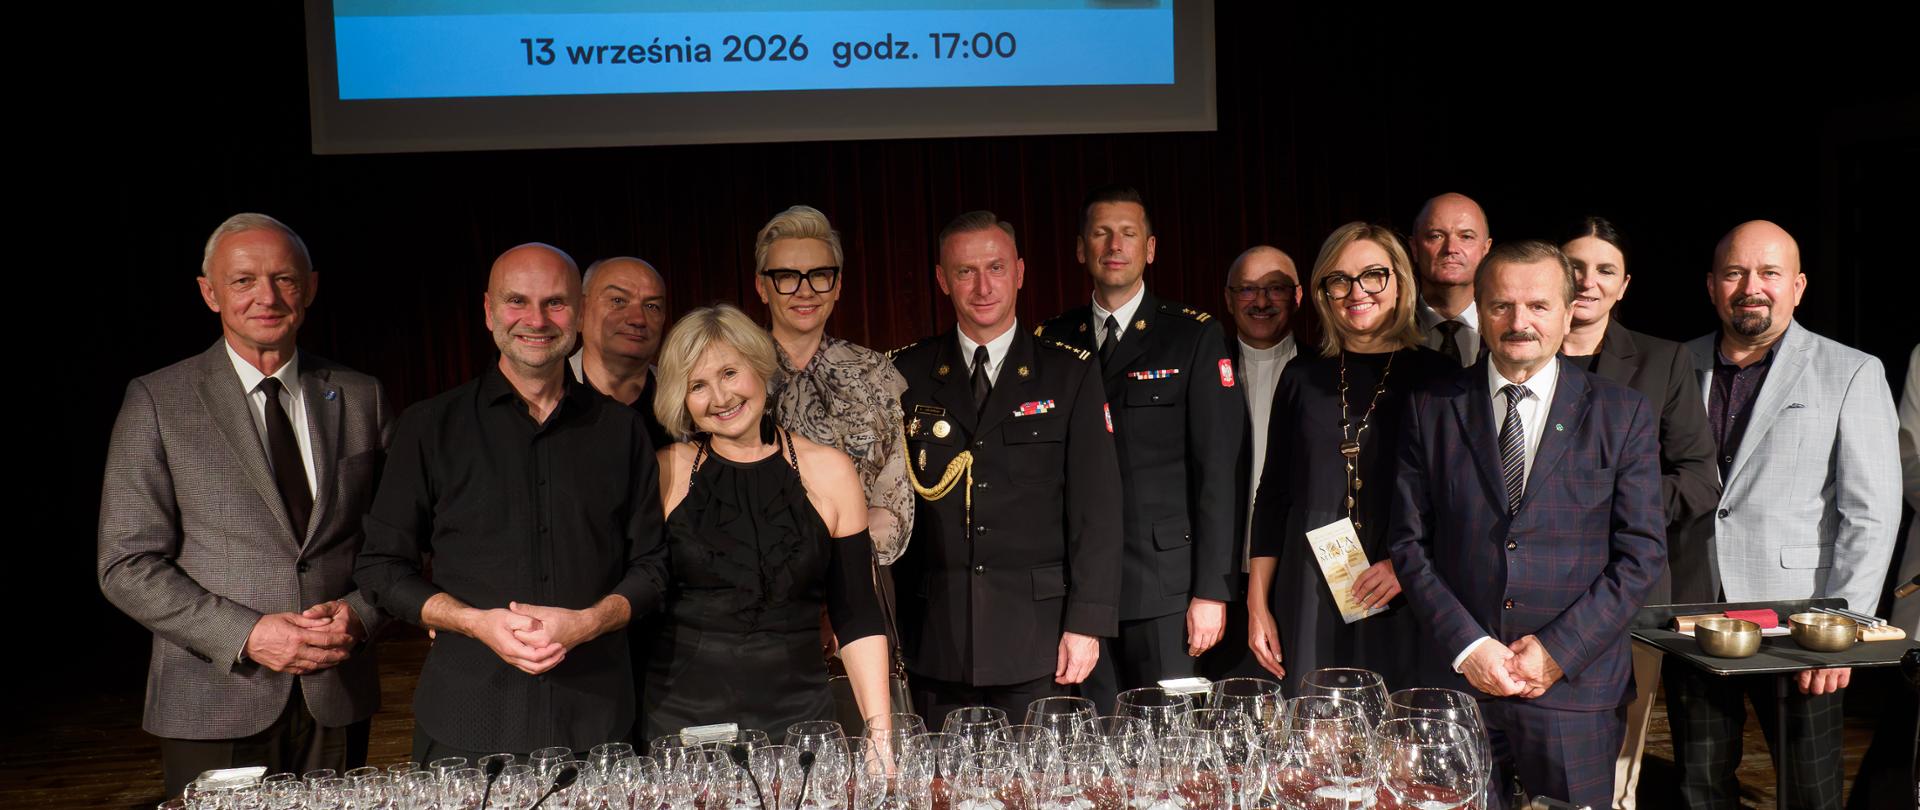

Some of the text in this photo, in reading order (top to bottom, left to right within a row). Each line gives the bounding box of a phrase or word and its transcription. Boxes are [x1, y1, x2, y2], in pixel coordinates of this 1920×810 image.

[520, 31, 1017, 69] 13 września 2026 godz. 17:00
